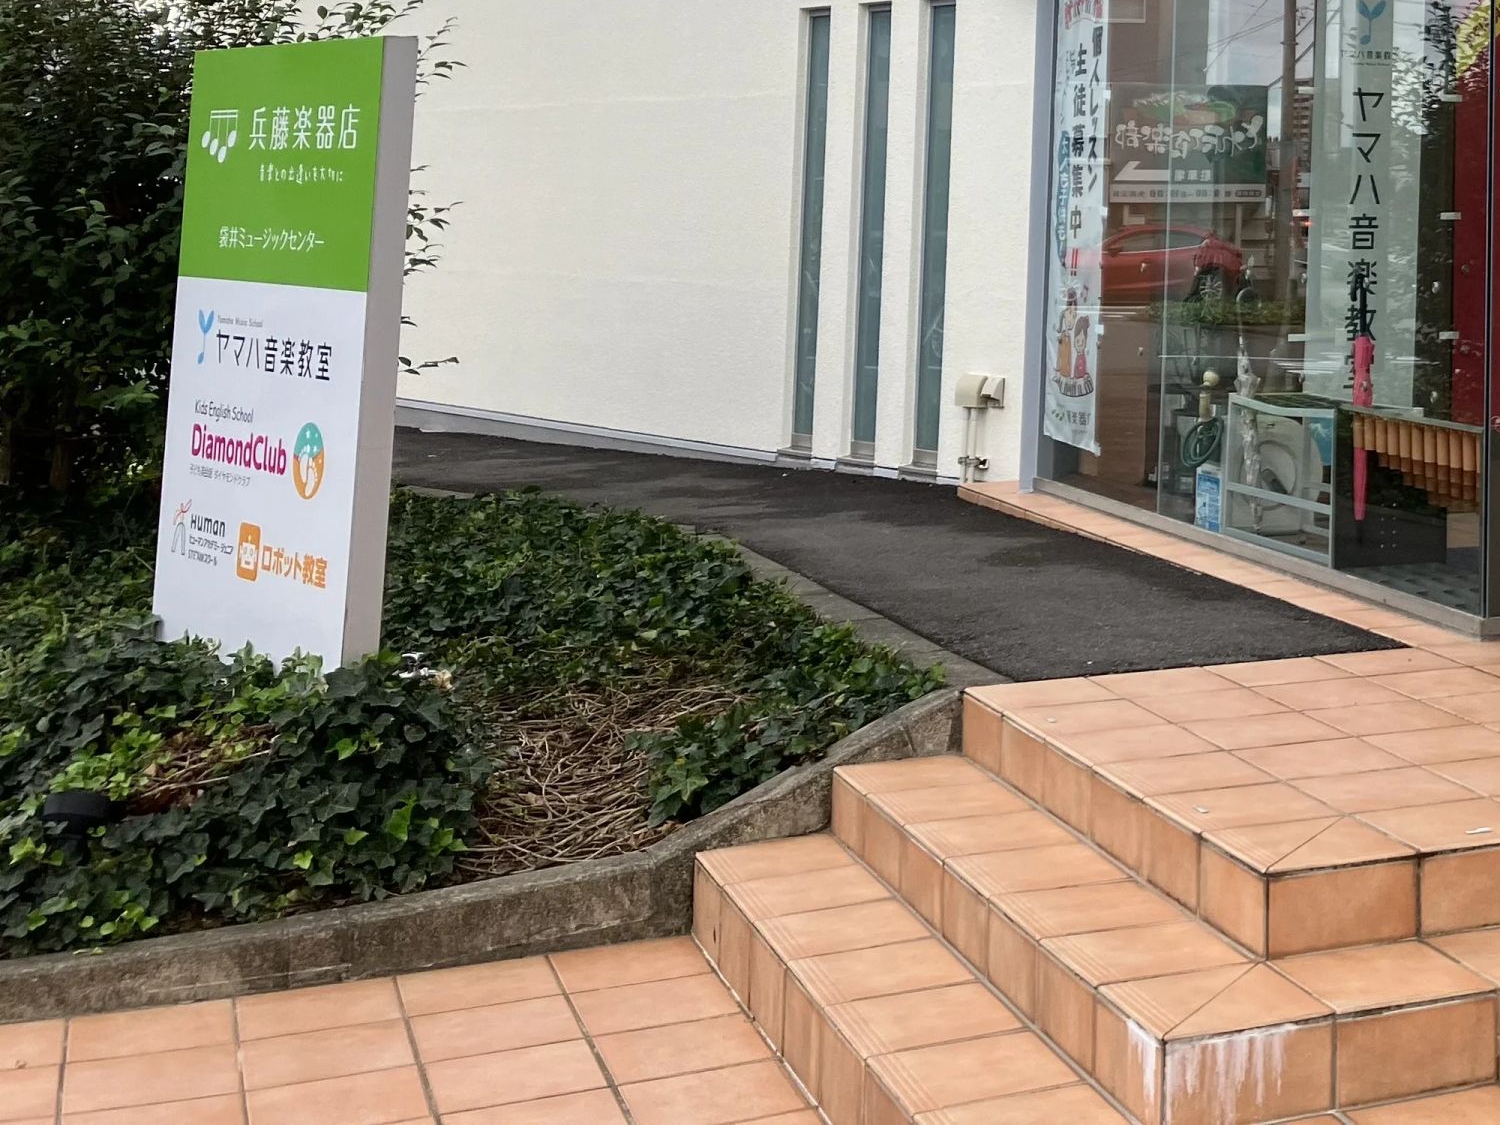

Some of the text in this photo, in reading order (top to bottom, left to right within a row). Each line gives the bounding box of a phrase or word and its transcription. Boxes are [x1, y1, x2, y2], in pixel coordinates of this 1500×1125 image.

[249, 104, 360, 150] 兵藤楽器店
[219, 226, 324, 252] 袋井ミュージックセンター
[216, 329, 332, 381] ヤマハ音楽教室
[195, 400, 254, 423] Kids English School
[191, 423, 287, 476] DiamondClub
[190, 513, 226, 538] Human
[261, 544, 328, 589] ロボット教室
